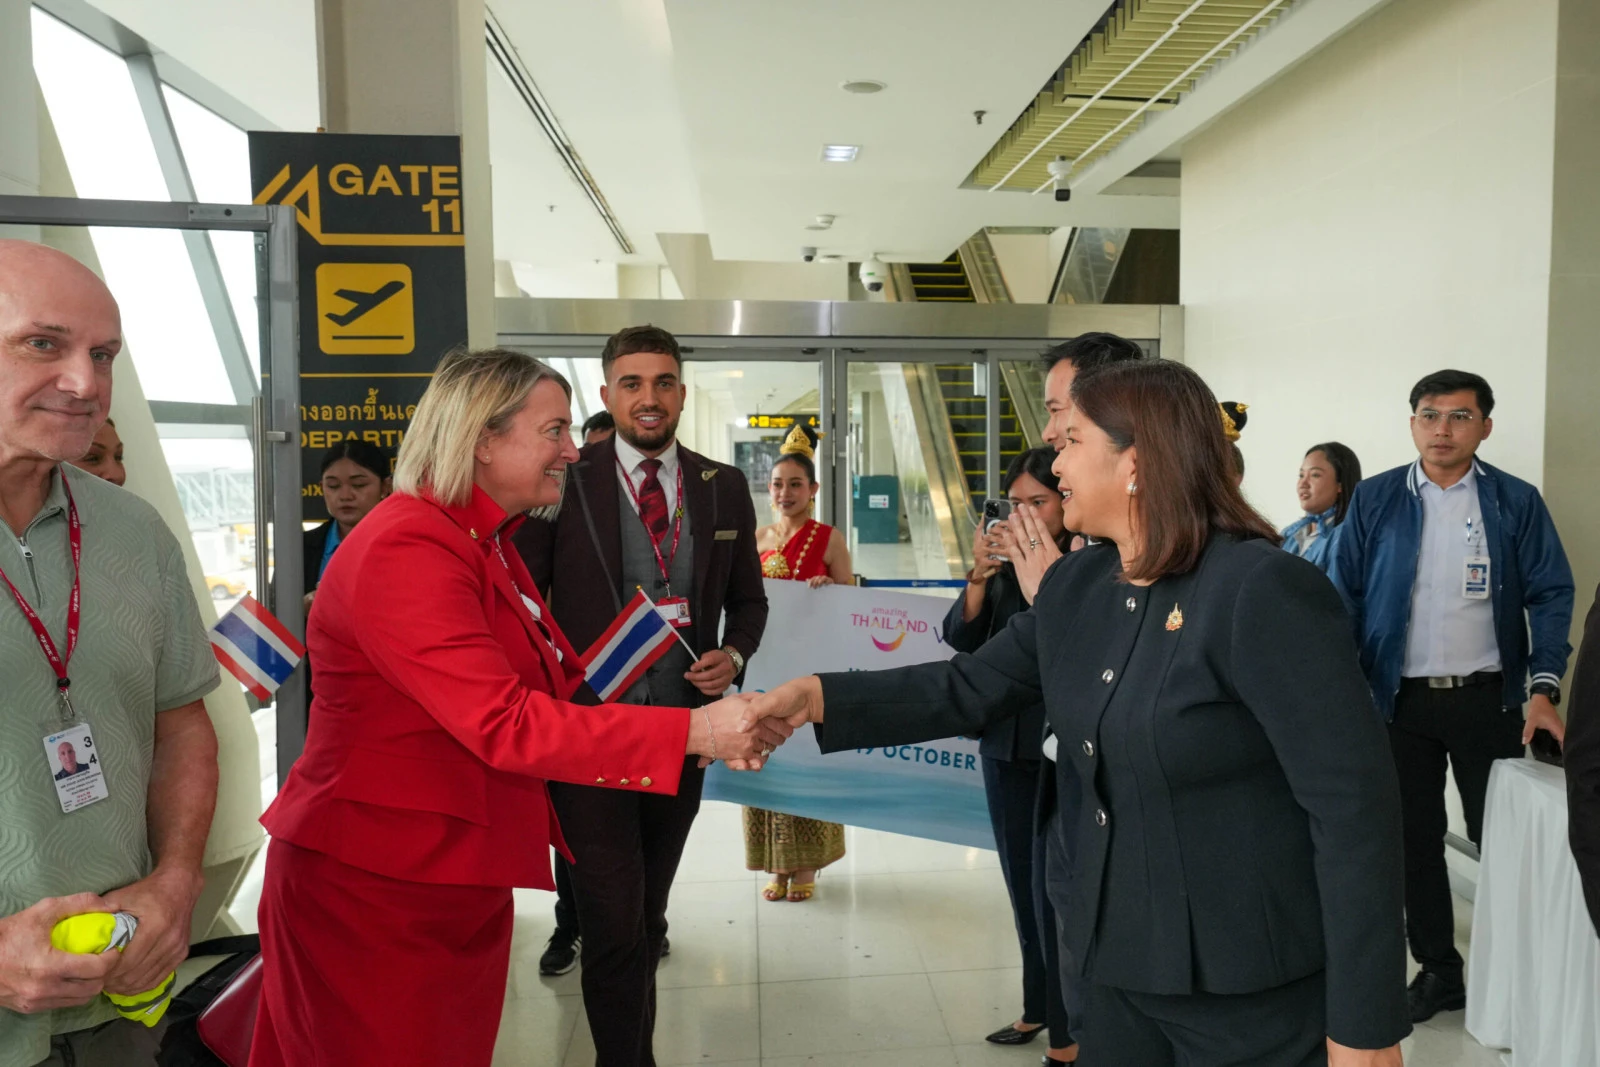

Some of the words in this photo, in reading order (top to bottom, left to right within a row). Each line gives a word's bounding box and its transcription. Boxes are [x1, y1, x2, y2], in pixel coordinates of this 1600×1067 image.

[328, 163, 459, 196] GATE
[421, 198, 461, 233] 11
[300, 387, 417, 421] างออกขึ้นเค
[850, 613, 928, 634] THAILAND
[871, 607, 908, 619] amazing
[83, 736, 93, 748] 3
[89, 753, 98, 765] 4
[883, 745, 977, 771] OCTOBER
